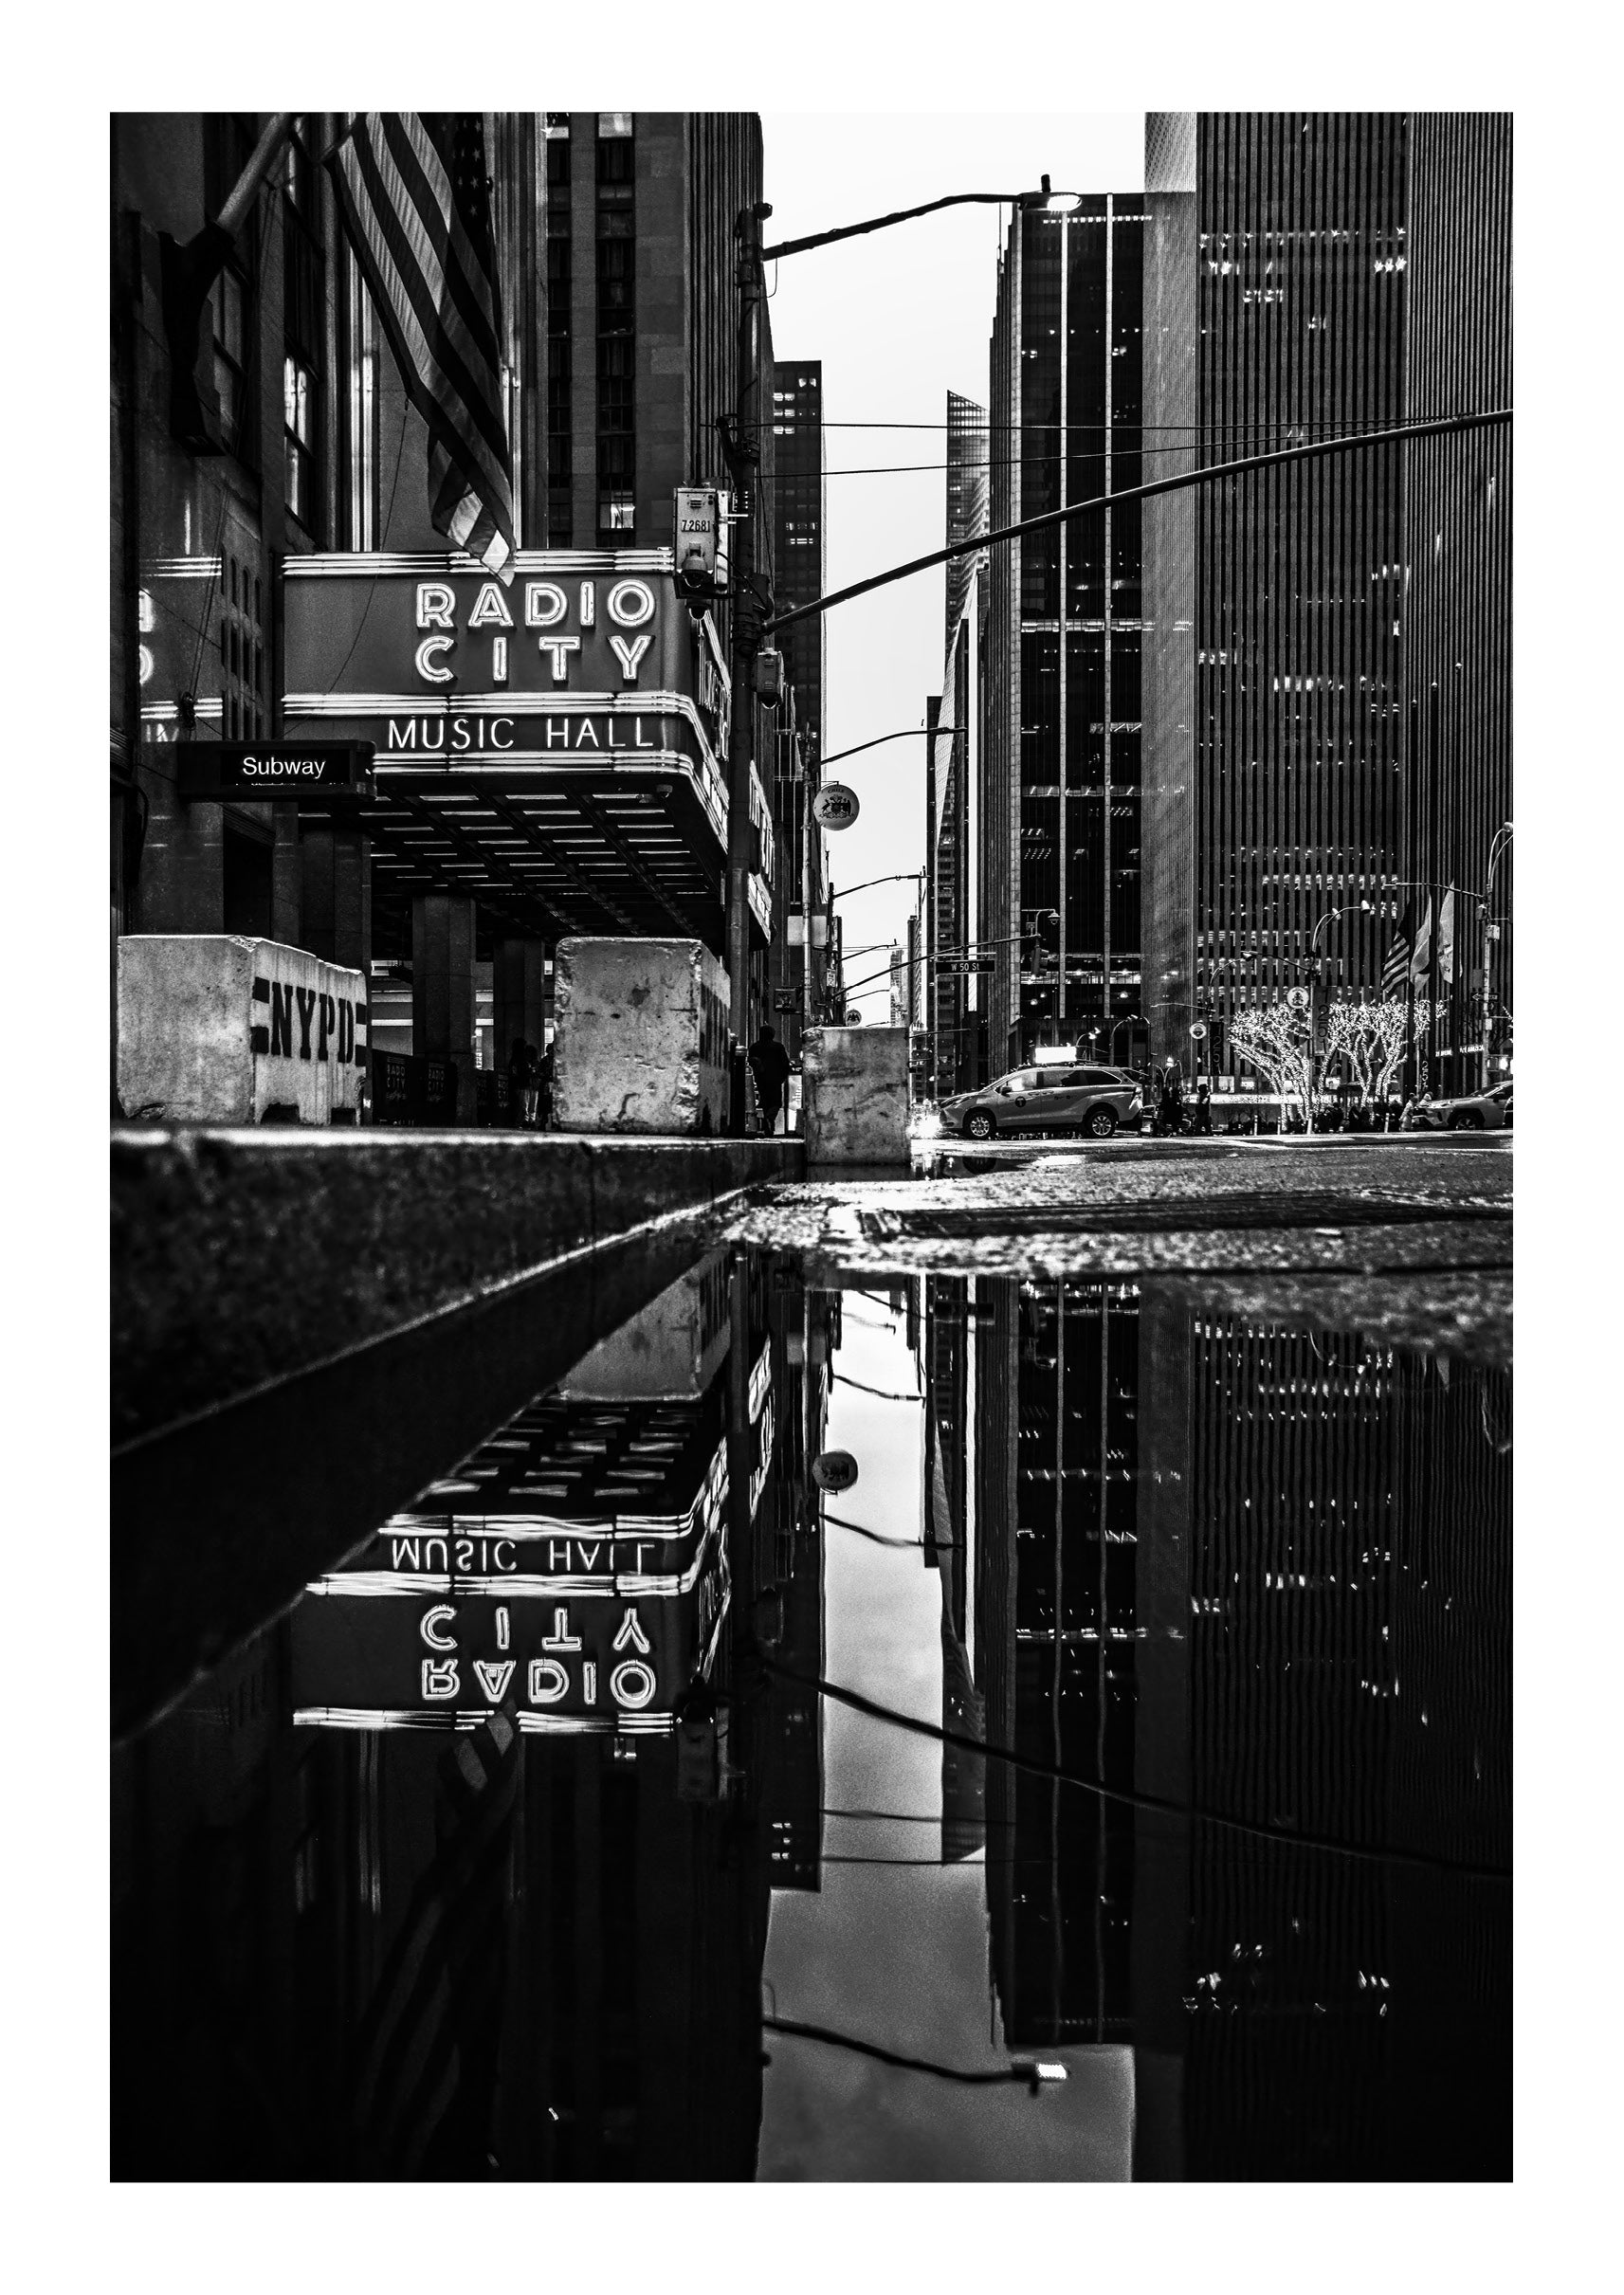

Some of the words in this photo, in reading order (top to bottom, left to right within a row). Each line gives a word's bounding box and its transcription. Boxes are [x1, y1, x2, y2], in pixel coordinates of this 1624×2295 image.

[415, 579, 656, 628] RADIO
[414, 635, 654, 683] CITY
[388, 718, 515, 750] MUSIC
[546, 717, 654, 749] HALL
[242, 756, 327, 779] Subway
[951, 963, 958, 972] W
[959, 962, 970, 972] 50
[972, 962, 980, 971] St
[271, 981, 355, 1064] NYPD
